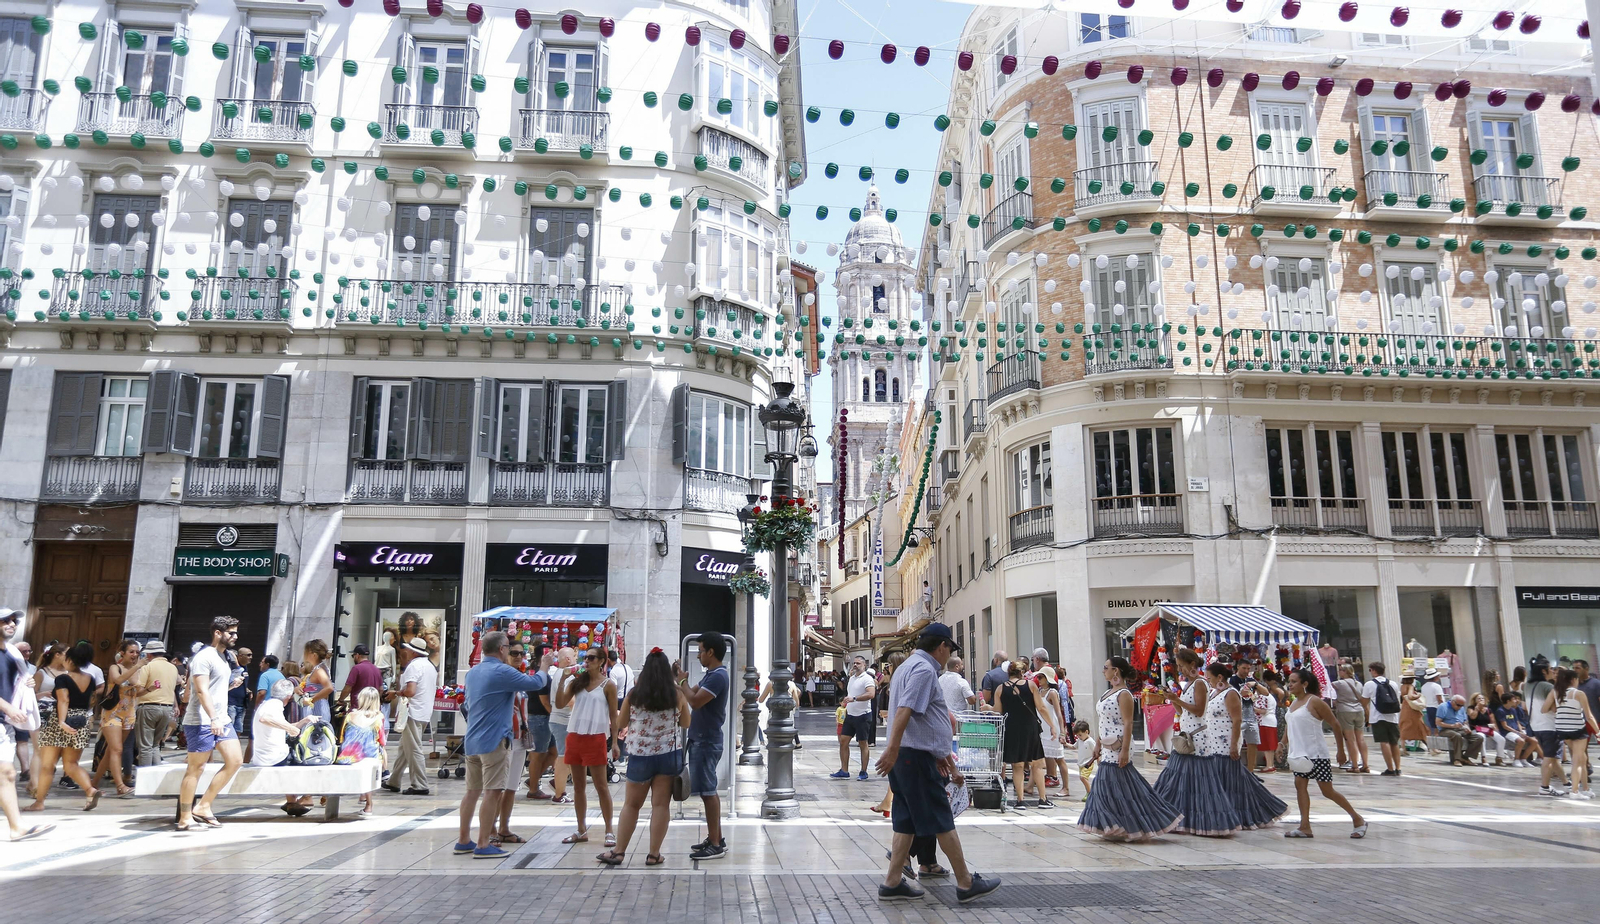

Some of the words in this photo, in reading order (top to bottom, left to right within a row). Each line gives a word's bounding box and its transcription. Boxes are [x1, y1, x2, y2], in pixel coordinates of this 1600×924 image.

[178, 557, 200, 566] THE
[203, 557, 237, 567] BODY
[371, 546, 434, 564] Etam
[516, 548, 578, 566] Etam
[696, 554, 739, 574] Etam
